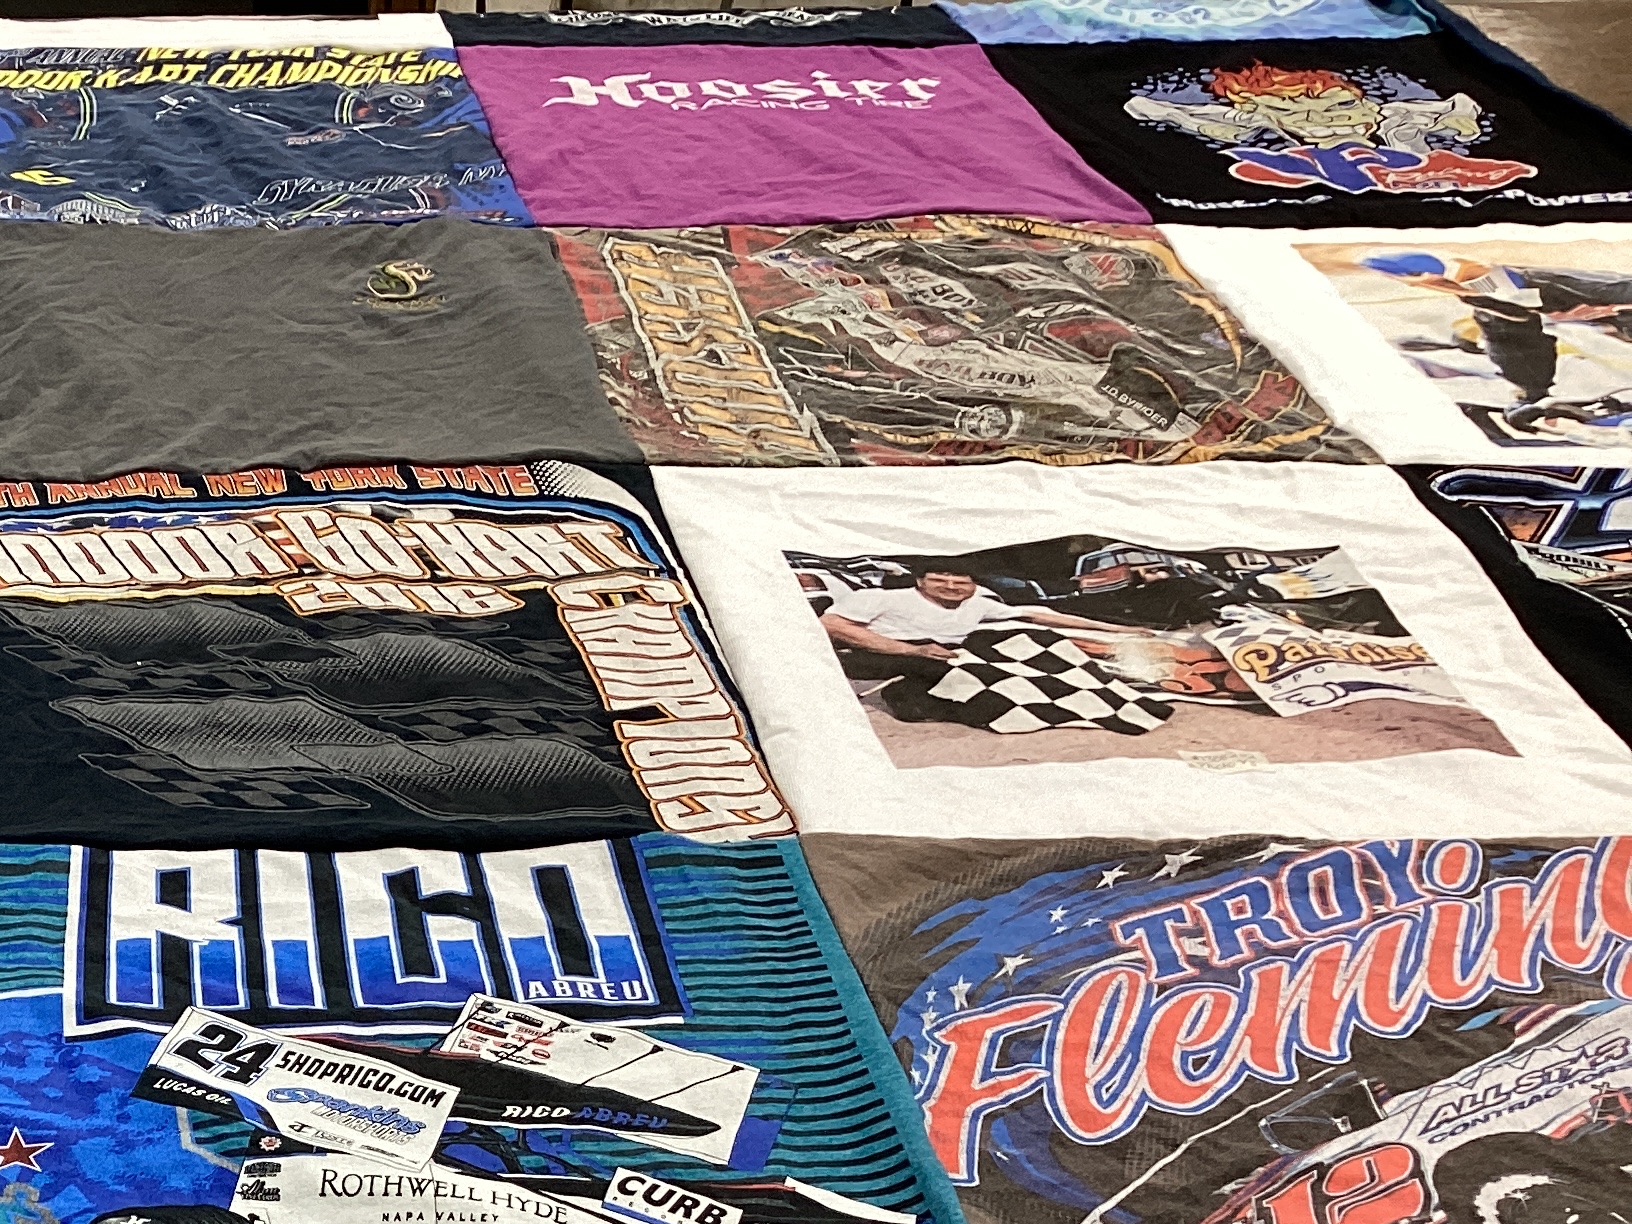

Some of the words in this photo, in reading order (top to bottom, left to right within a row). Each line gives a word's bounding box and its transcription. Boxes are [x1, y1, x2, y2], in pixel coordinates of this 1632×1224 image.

[137, 46, 215, 64] NEW
[324, 45, 428, 67] STATE
[542, 70, 942, 108] Hoosier
[670, 98, 830, 111] RACING
[846, 97, 932, 110] TIRE
[49, 475, 198, 504] ANNUAL
[209, 470, 289, 497] NEW
[305, 465, 402, 493] YORK
[411, 464, 540, 497] STATE
[273, 576, 526, 616] 2016
[1233, 638, 1434, 683] Paradise
[104, 843, 648, 1010] RICO
[1109, 836, 1443, 986] TROY
[527, 979, 644, 1001] ABREU
[169, 1019, 282, 1087] 24
[152, 1077, 206, 1099] LUCAS
[206, 1091, 231, 1106] OIL
[274, 1050, 447, 1109] SHOPRICO.COM
[308, 1105, 418, 1146] MOTORSPORTS
[501, 1104, 571, 1119] RICO
[571, 1106, 669, 1129] ABREU
[318, 1168, 483, 1203] ROTHWELL
[382, 1211, 426, 1222] NAPA
[435, 1211, 500, 1223] VALLEY
